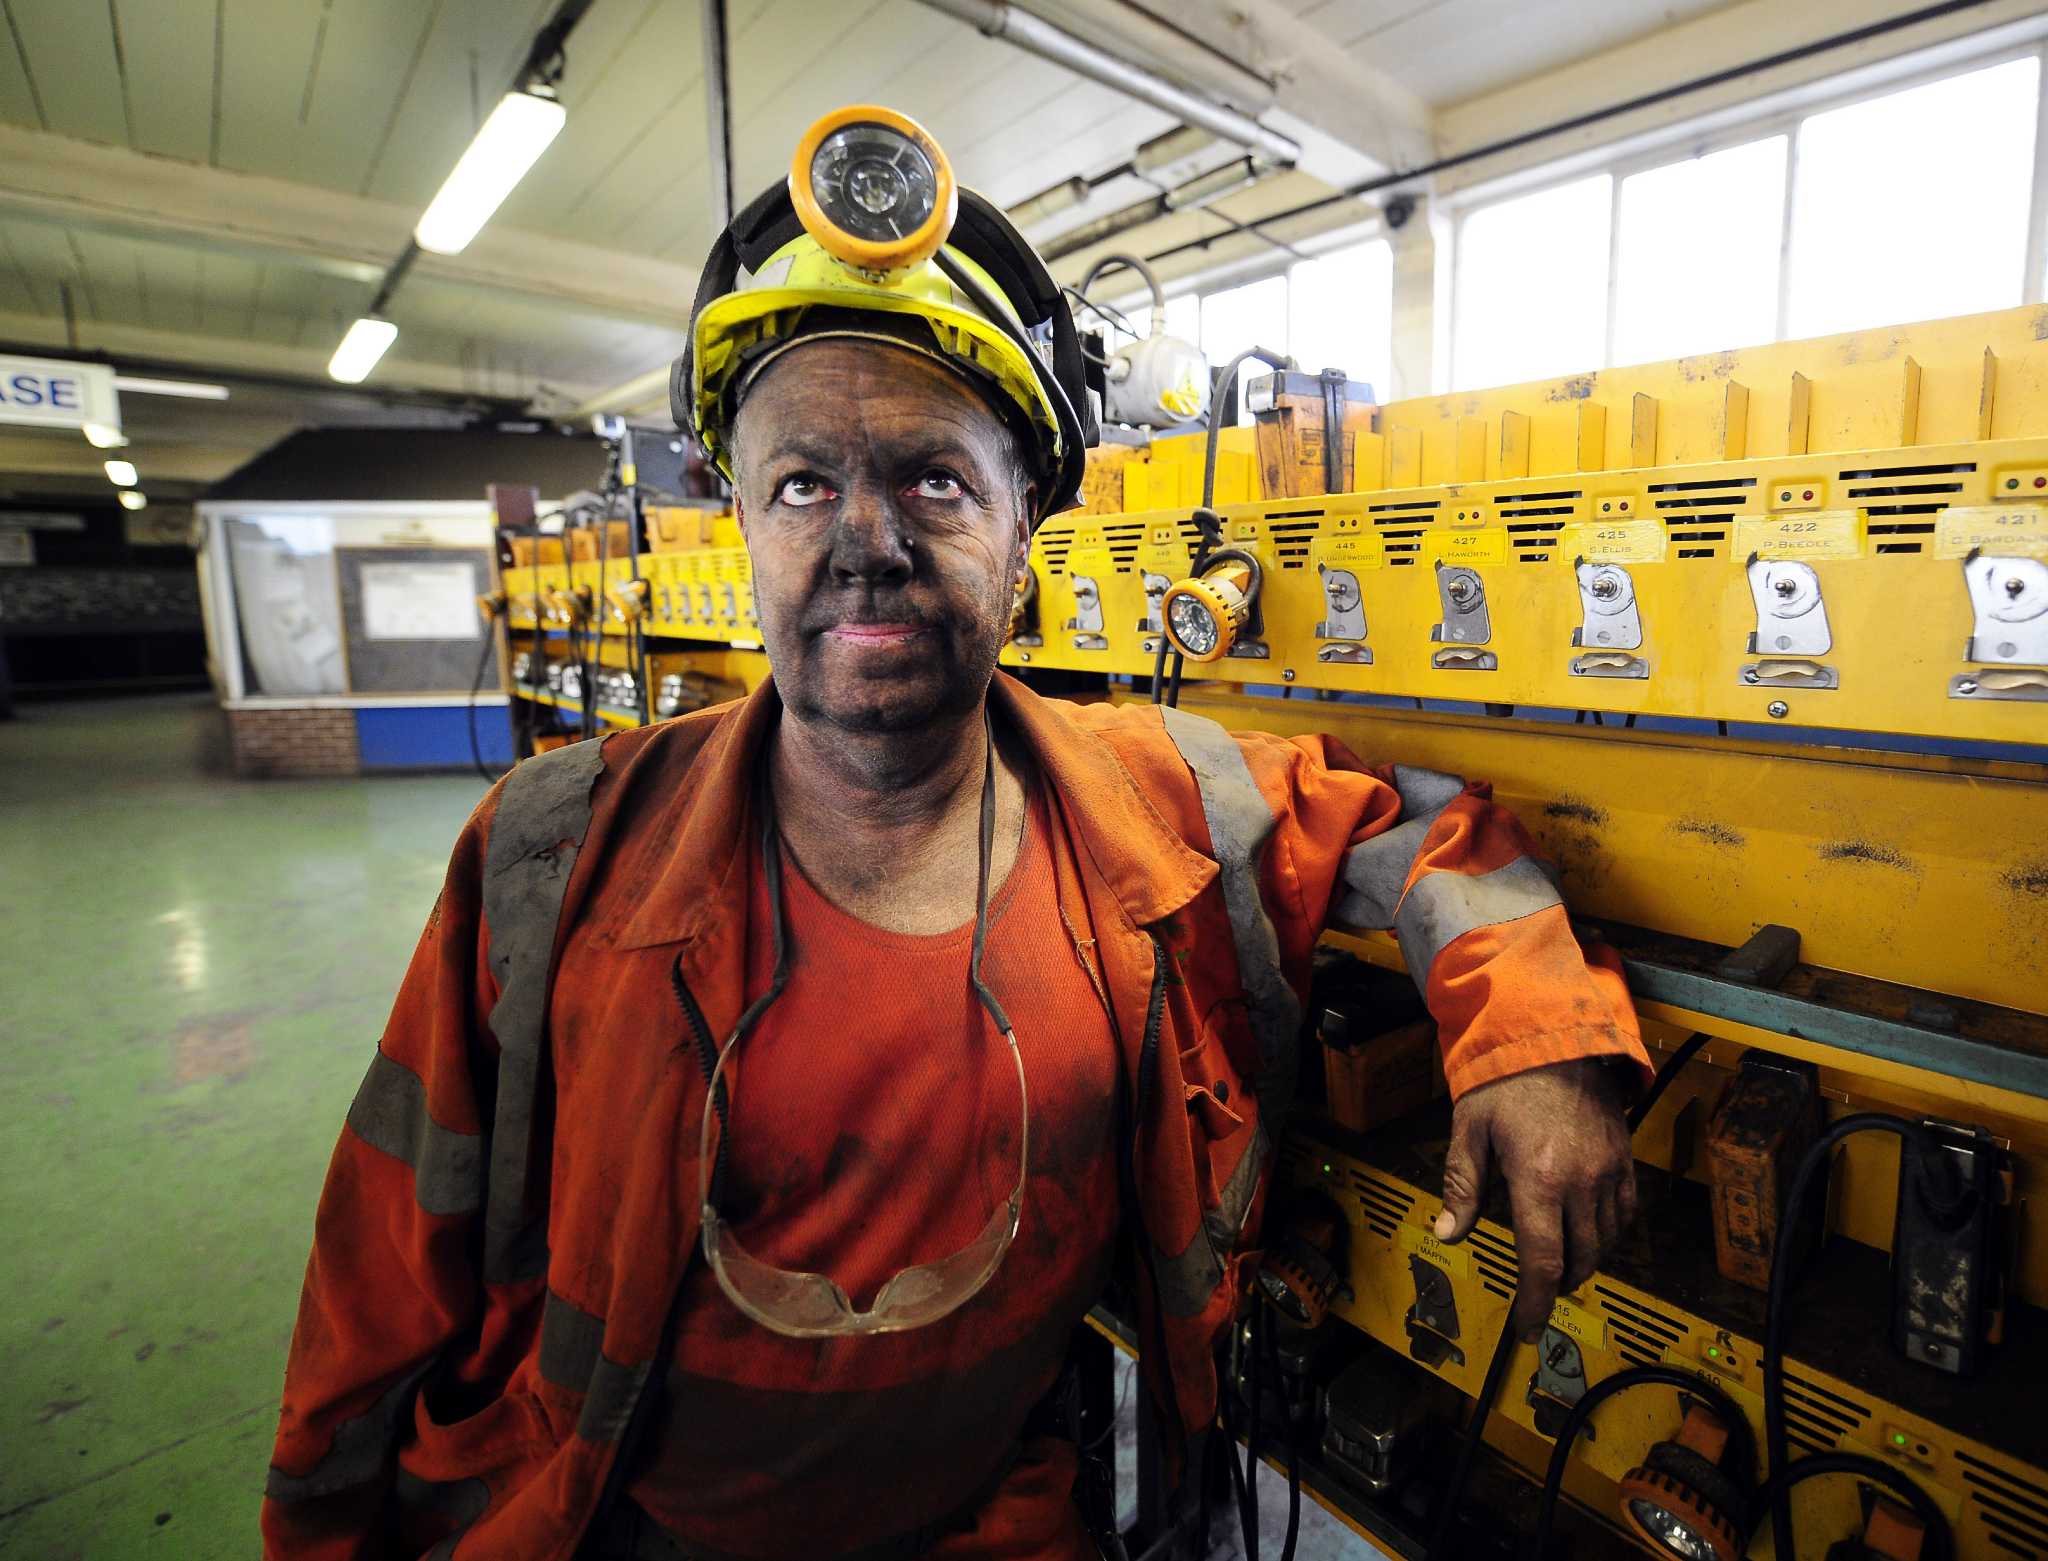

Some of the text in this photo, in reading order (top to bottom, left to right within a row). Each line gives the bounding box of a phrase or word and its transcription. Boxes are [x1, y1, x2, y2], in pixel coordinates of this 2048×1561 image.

[0, 376, 79, 409] SE
[1995, 514, 2037, 525] 421
[1780, 522, 1817, 533] 422
[1596, 530, 1627, 539] 425
[1335, 542, 1356, 550] 445
[1453, 537, 1477, 545] 427
[1447, 551, 1491, 559] HAWORTH
[1420, 1246, 1451, 1267] MARTIN
[1552, 1303, 1570, 1317] 15
[1550, 1314, 1582, 1335] ALLEN
